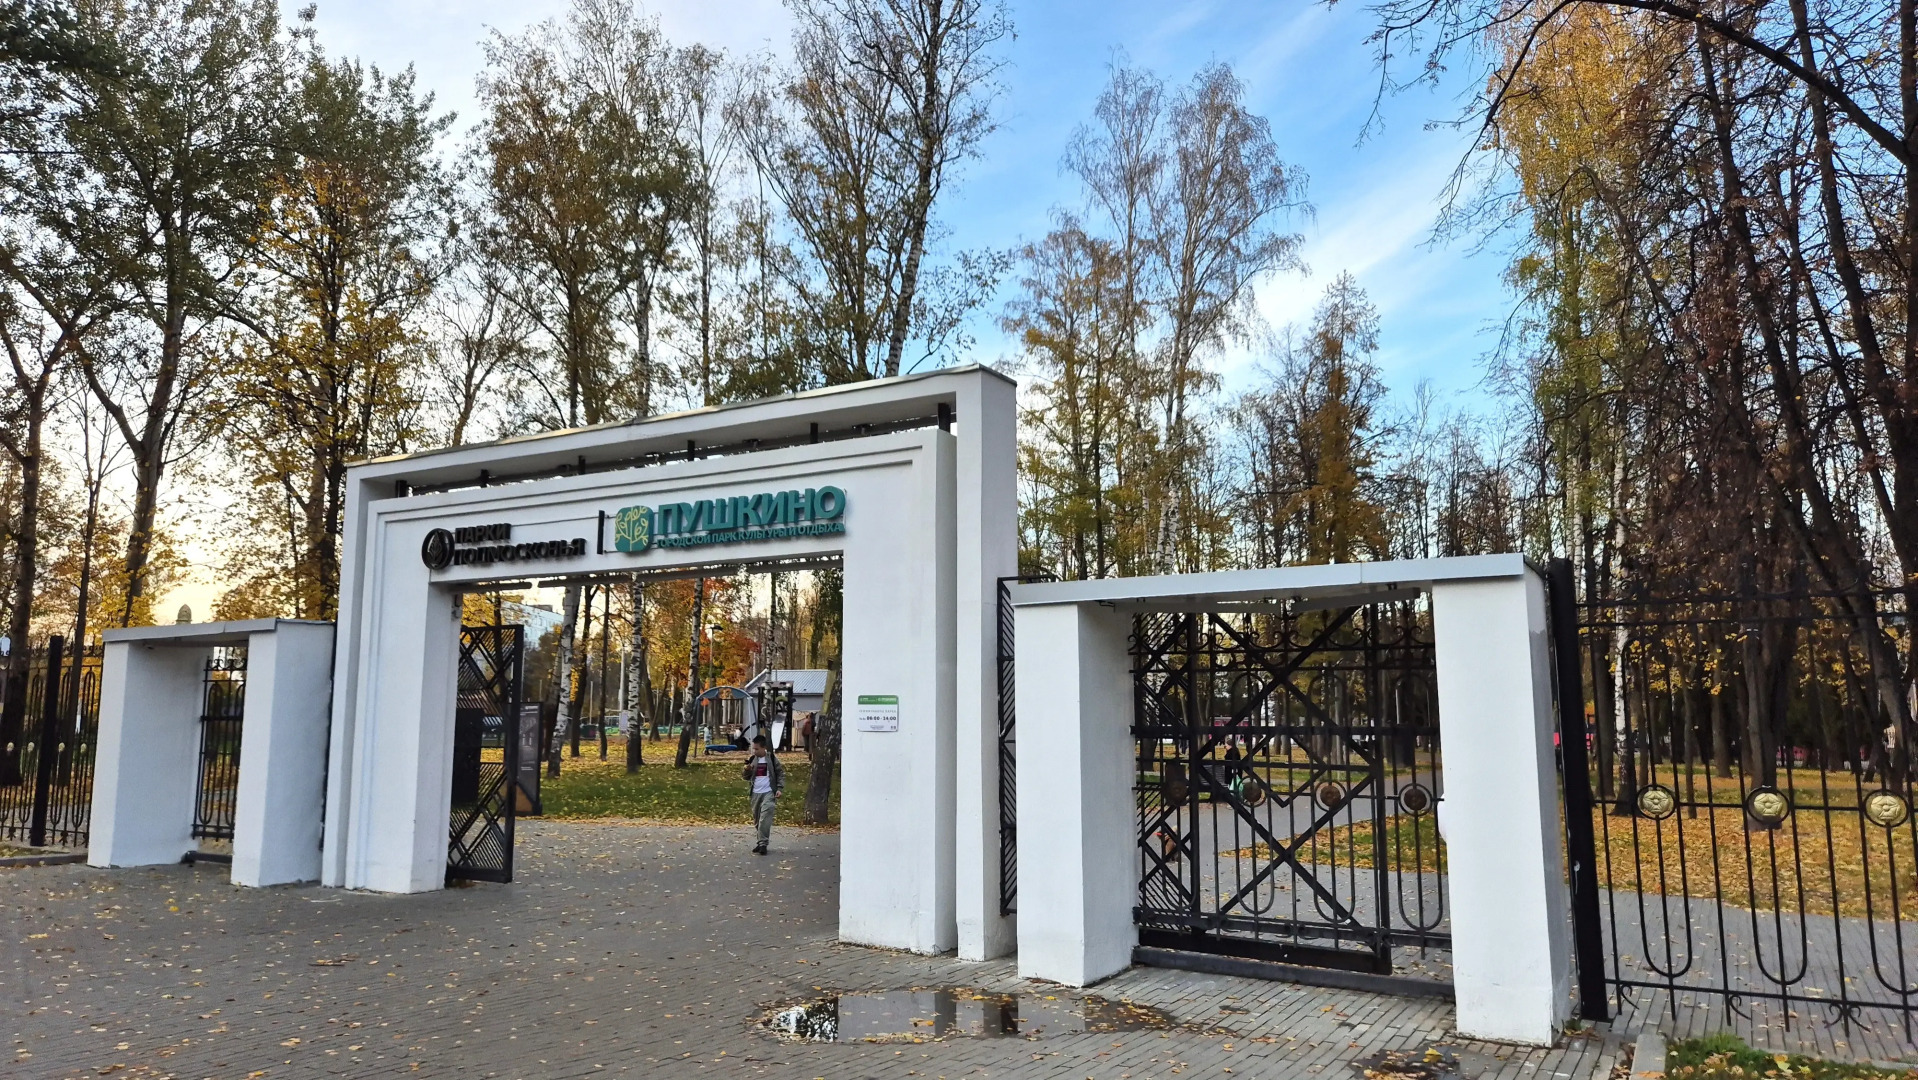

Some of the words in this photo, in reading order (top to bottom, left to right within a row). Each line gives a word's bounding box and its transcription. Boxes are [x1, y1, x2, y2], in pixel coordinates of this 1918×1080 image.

[658, 485, 846, 534] ПУШКИНО
[455, 523, 511, 543] ПАРКИ
[657, 533, 711, 547] ГОРОДСКОЙ
[711, 531, 738, 543] ПАРК
[738, 528, 788, 541] КУЛЬТУРЫ
[788, 526, 797, 537] И
[797, 522, 846, 534] ОТДЫХА
[454, 538, 586, 565] ПОДМОСКОВЬЯ
